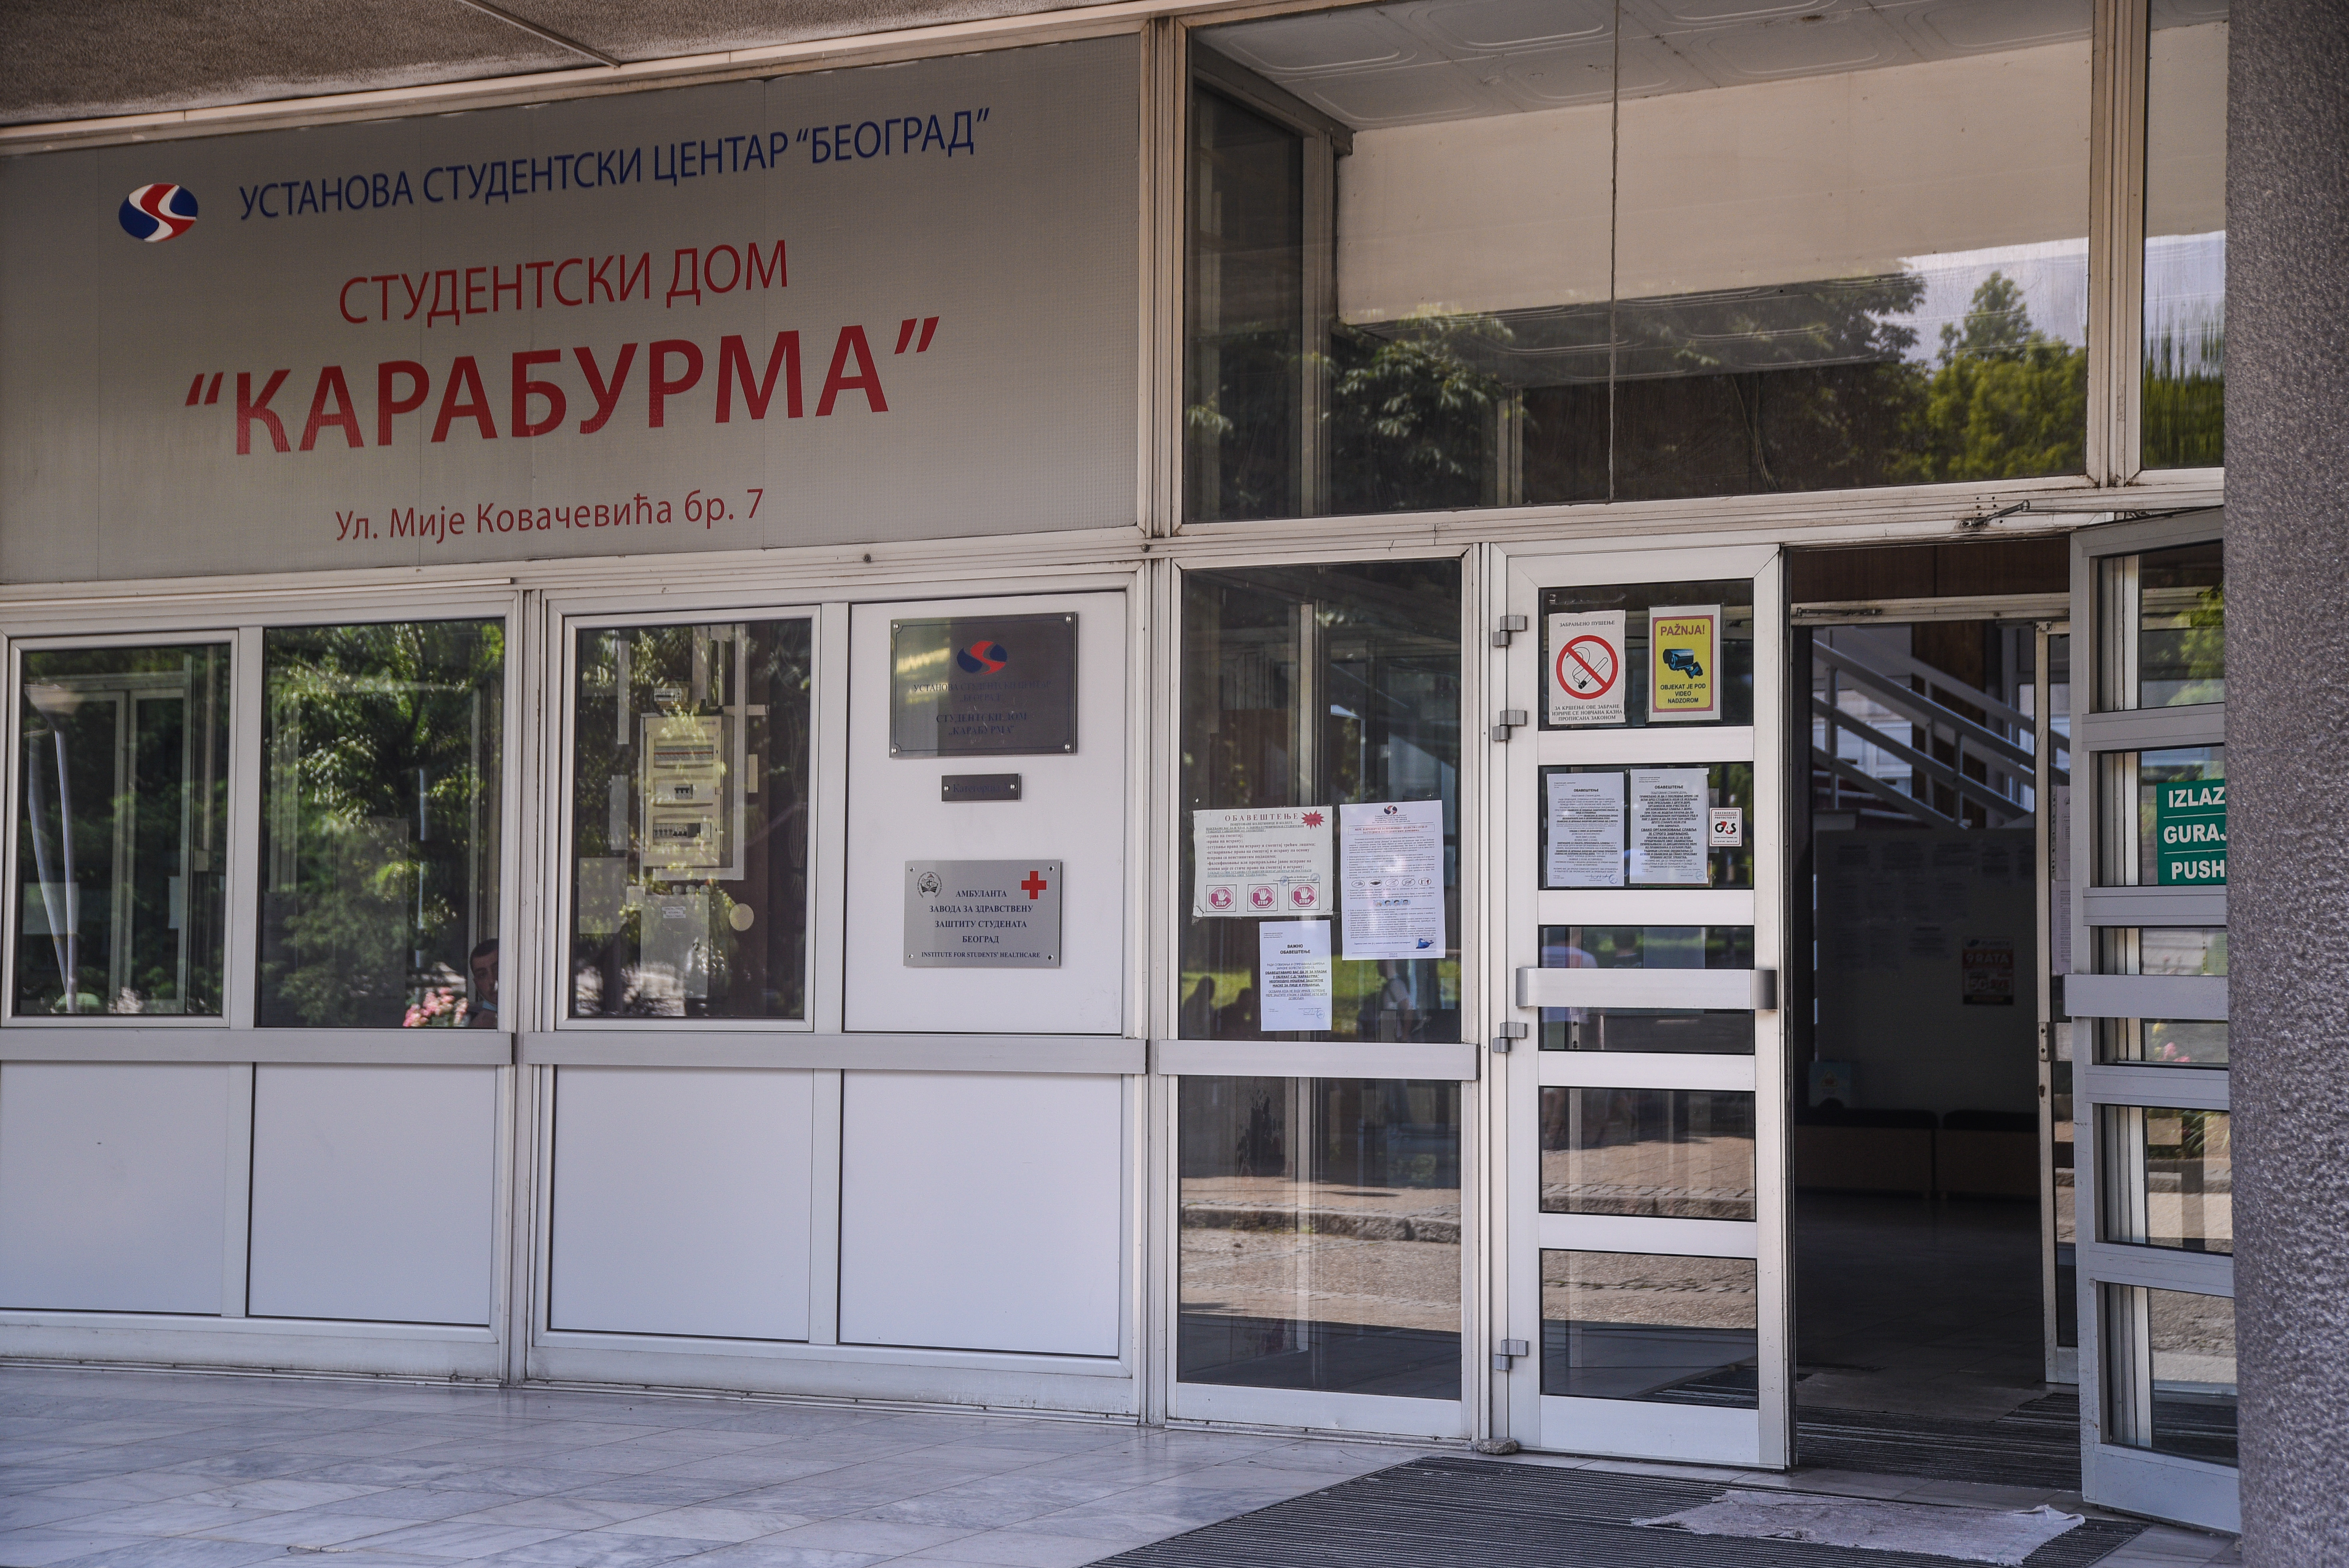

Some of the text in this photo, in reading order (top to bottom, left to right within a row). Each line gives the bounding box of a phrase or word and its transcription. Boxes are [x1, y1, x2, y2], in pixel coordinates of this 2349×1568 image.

[239, 107, 990, 220] УСТАНОВА СТУДЕНТСКИ ЦЕНТАР “БЕОГРАД”
[339, 239, 787, 328] СТУДЕНТСКИ ДОМ
[185, 316, 940, 455] “КАРАБУРМА”
[335, 488, 763, 546] Ул. Мије Ковачевића бр. 7
[1661, 624, 1705, 636] PAŽNJA!
[914, 684, 958, 692] УСТАНОВА
[936, 713, 1001, 723] СТУДЕНТСКИ
[2169, 787, 2225, 808] IZLAZ
[1225, 813, 1298, 821] ОБАВЕШТЕЊЕ
[1715, 821, 1736, 834] G4S
[2172, 860, 2225, 880] PUSH
[929, 905, 961, 913] ЗАВОДА
[976, 905, 1033, 913] ЗДРАВСТВЕНУ
[978, 920, 1027, 928] СТУДЕНАТА
